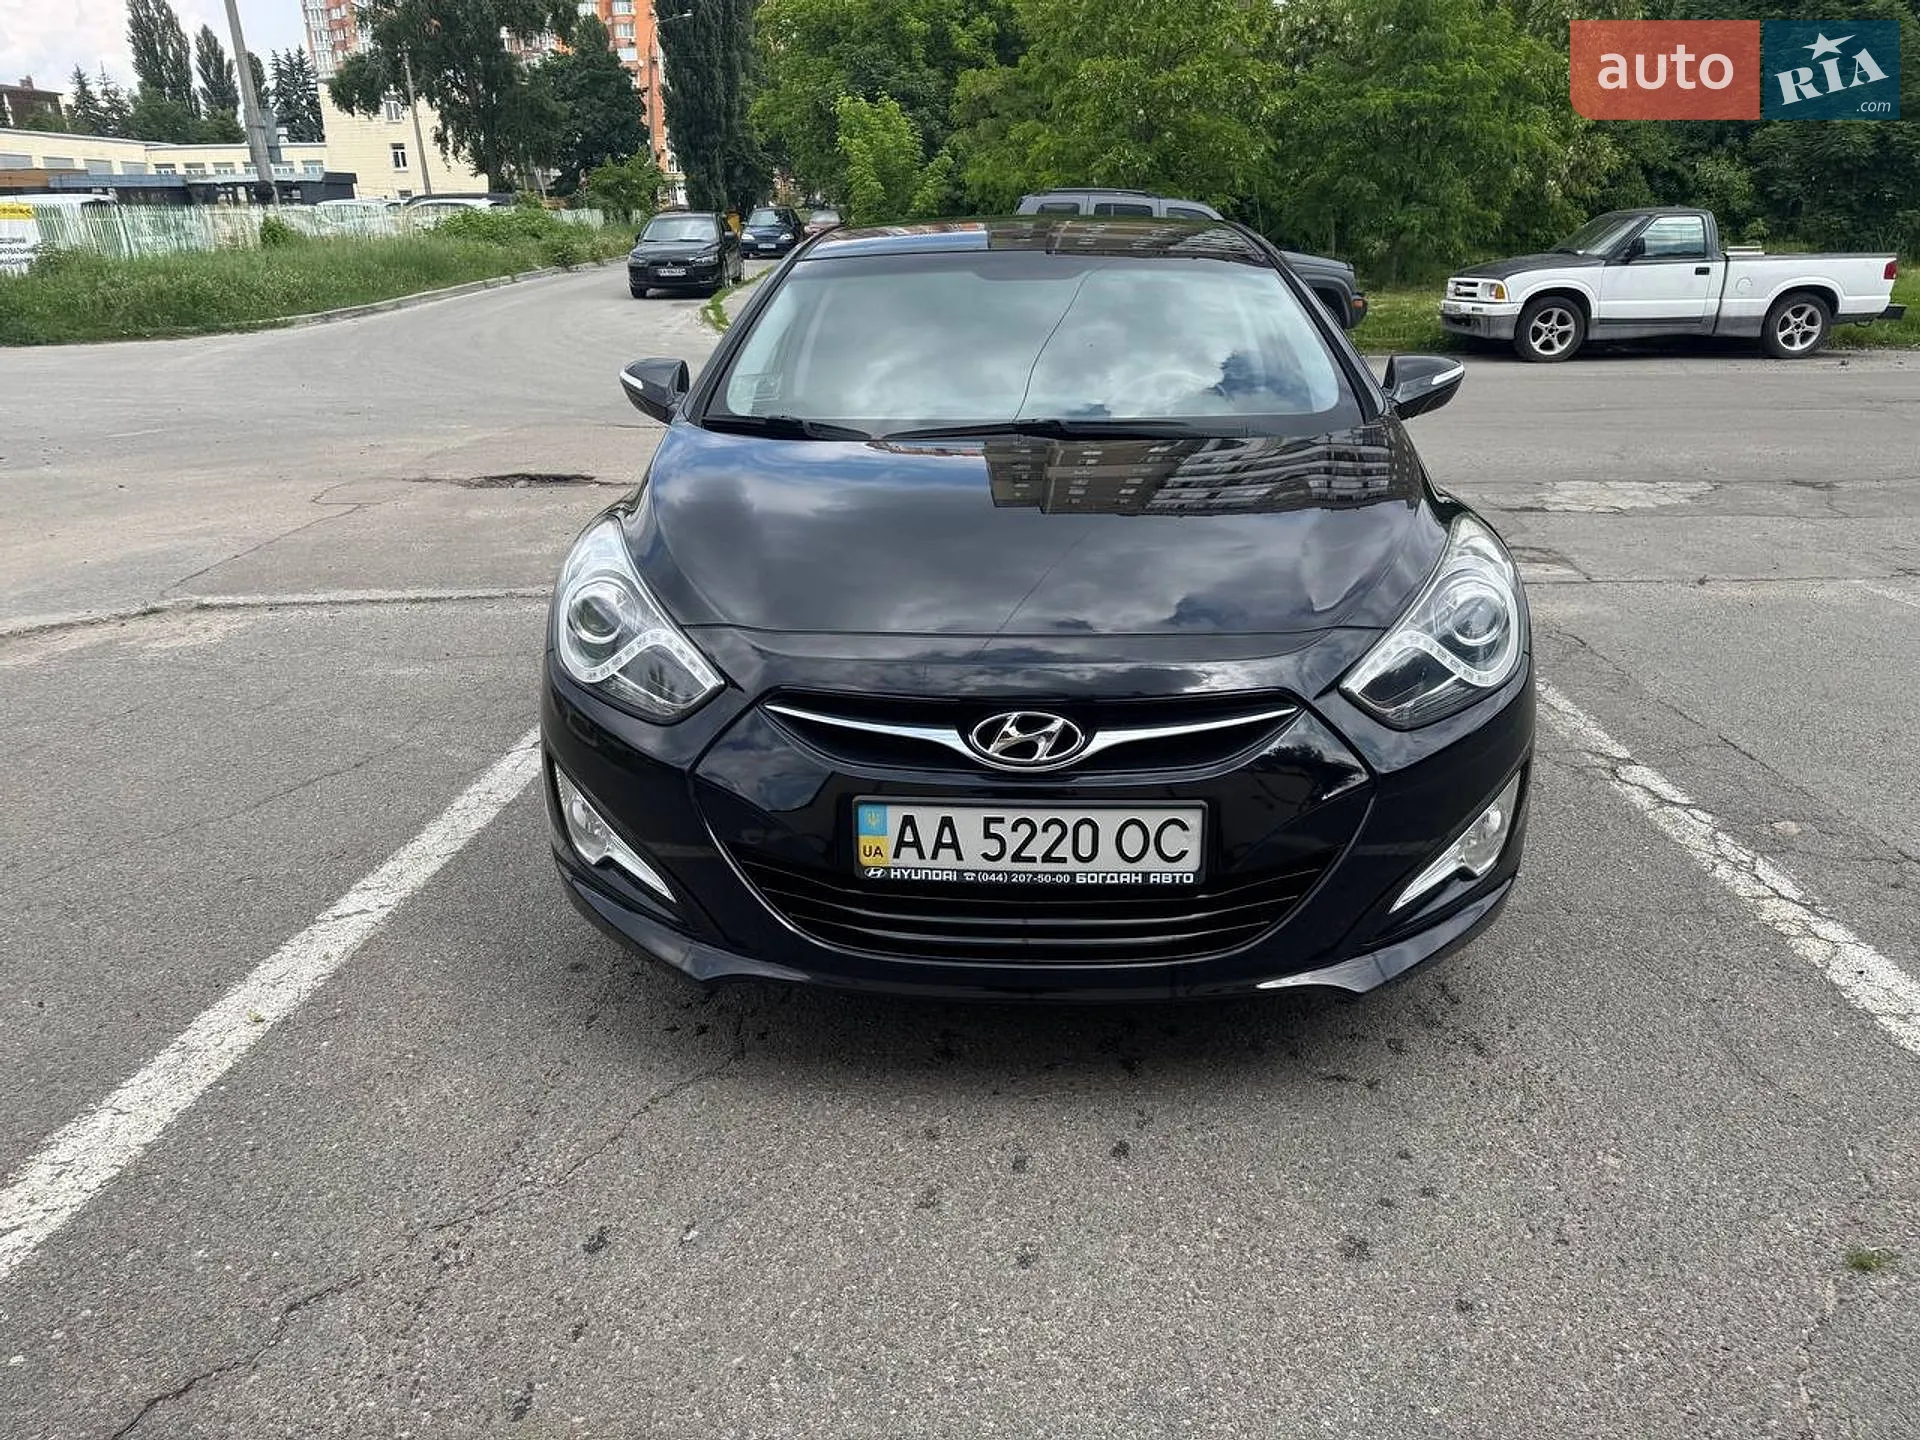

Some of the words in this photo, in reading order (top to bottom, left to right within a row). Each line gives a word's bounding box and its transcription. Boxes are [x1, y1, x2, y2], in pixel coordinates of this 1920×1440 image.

[893, 814, 964, 861] AA
[980, 816, 1099, 864] 5220
[1115, 817, 1191, 864] OC
[862, 845, 884, 859] UA
[890, 868, 957, 881] HYUNDAI
[977, 872, 1008, 883] (044)
[1011, 873, 1071, 884] 207-50-00
[1075, 873, 1143, 884] БОГДАН
[1149, 872, 1195, 884] АВТО
